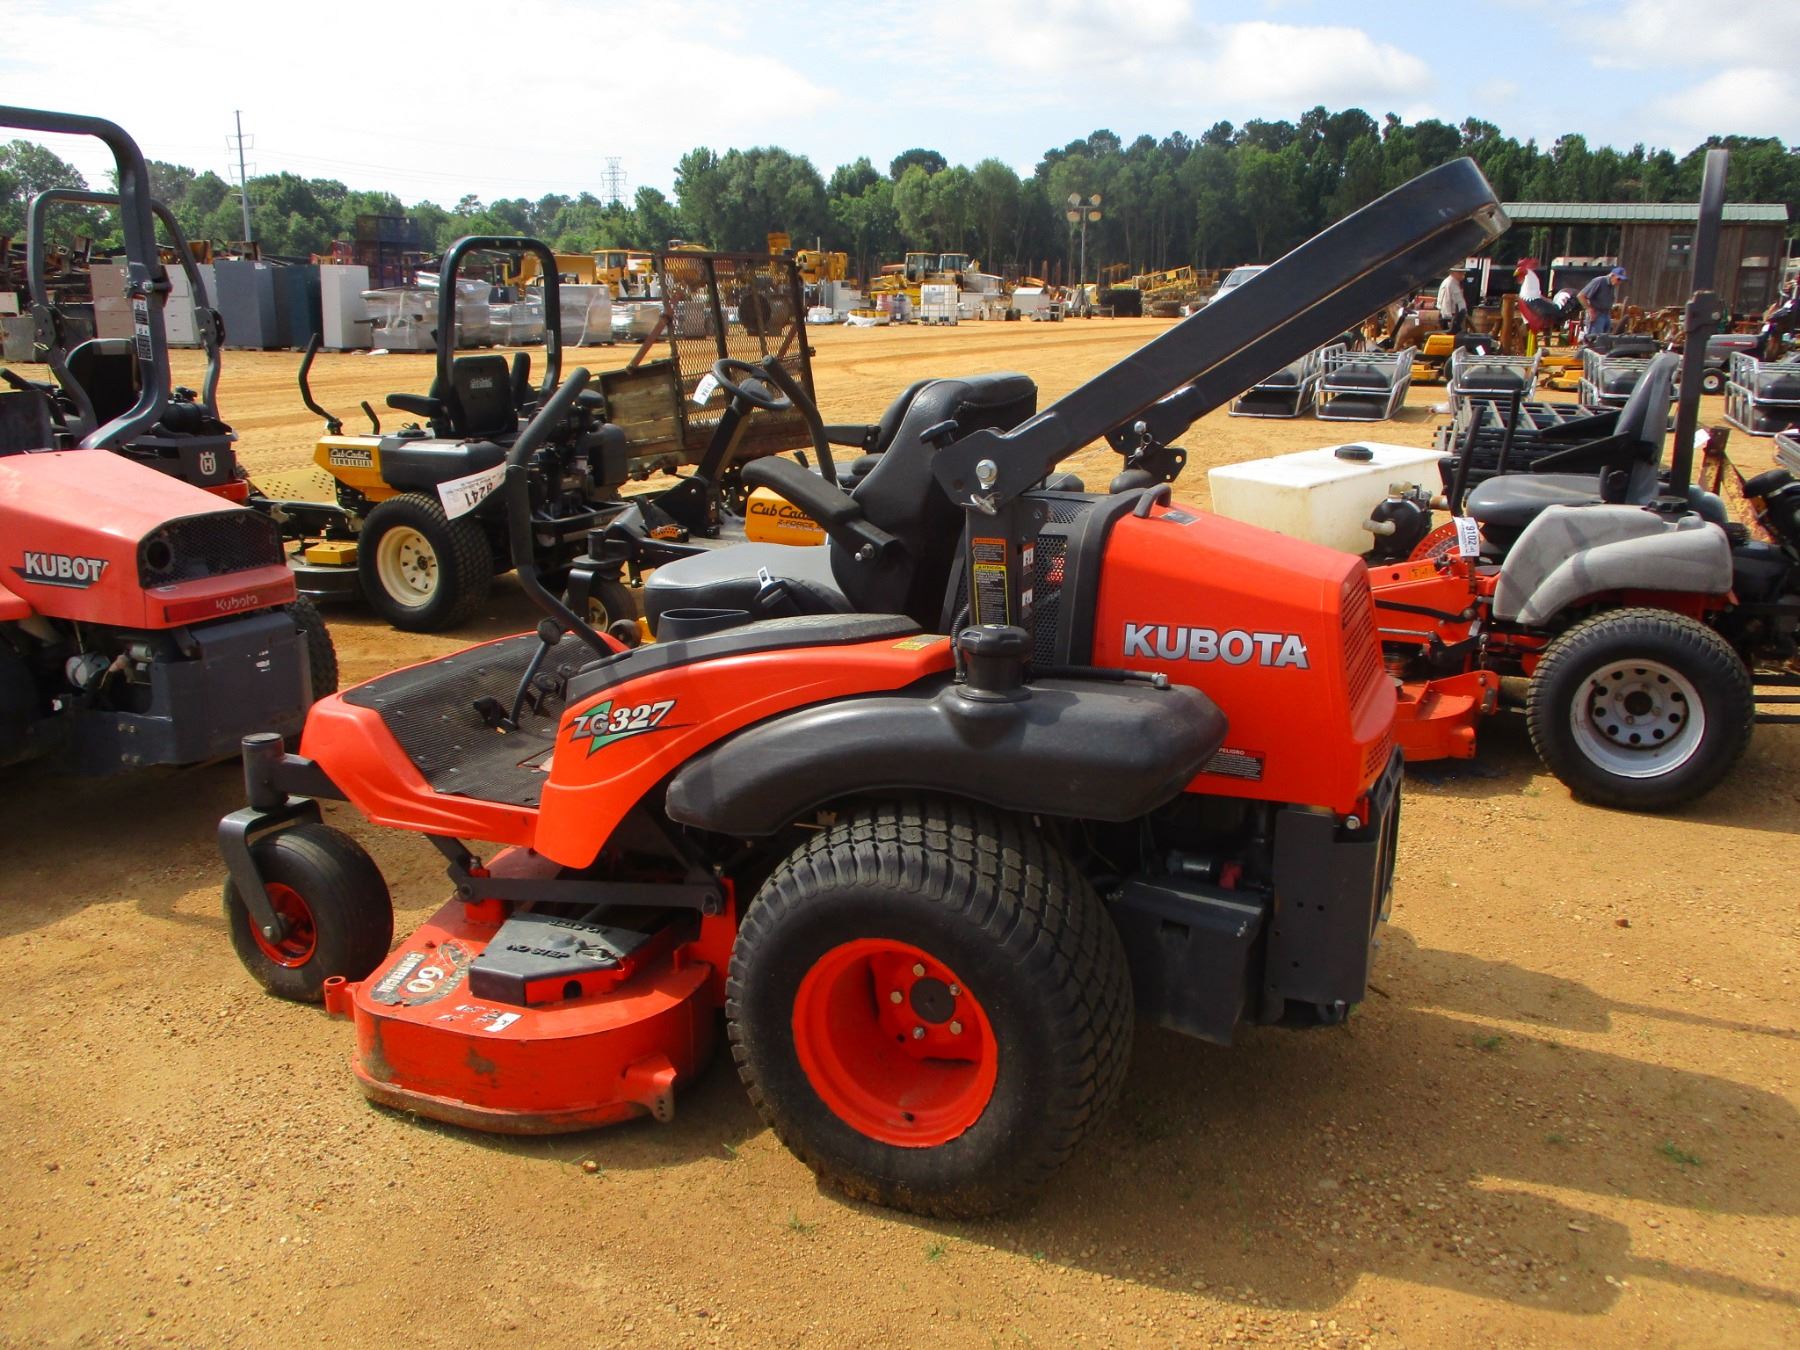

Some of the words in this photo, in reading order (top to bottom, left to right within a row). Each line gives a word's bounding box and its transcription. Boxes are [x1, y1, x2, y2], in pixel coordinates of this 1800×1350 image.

[750, 502, 777, 516] Cub
[1465, 525, 1478, 546] 9102
[215, 594, 259, 611] Kubota
[1123, 623, 1310, 669] KUBOTA
[571, 699, 677, 740] ZG327
[531, 948, 571, 959] STEP
[406, 966, 444, 993] 60
